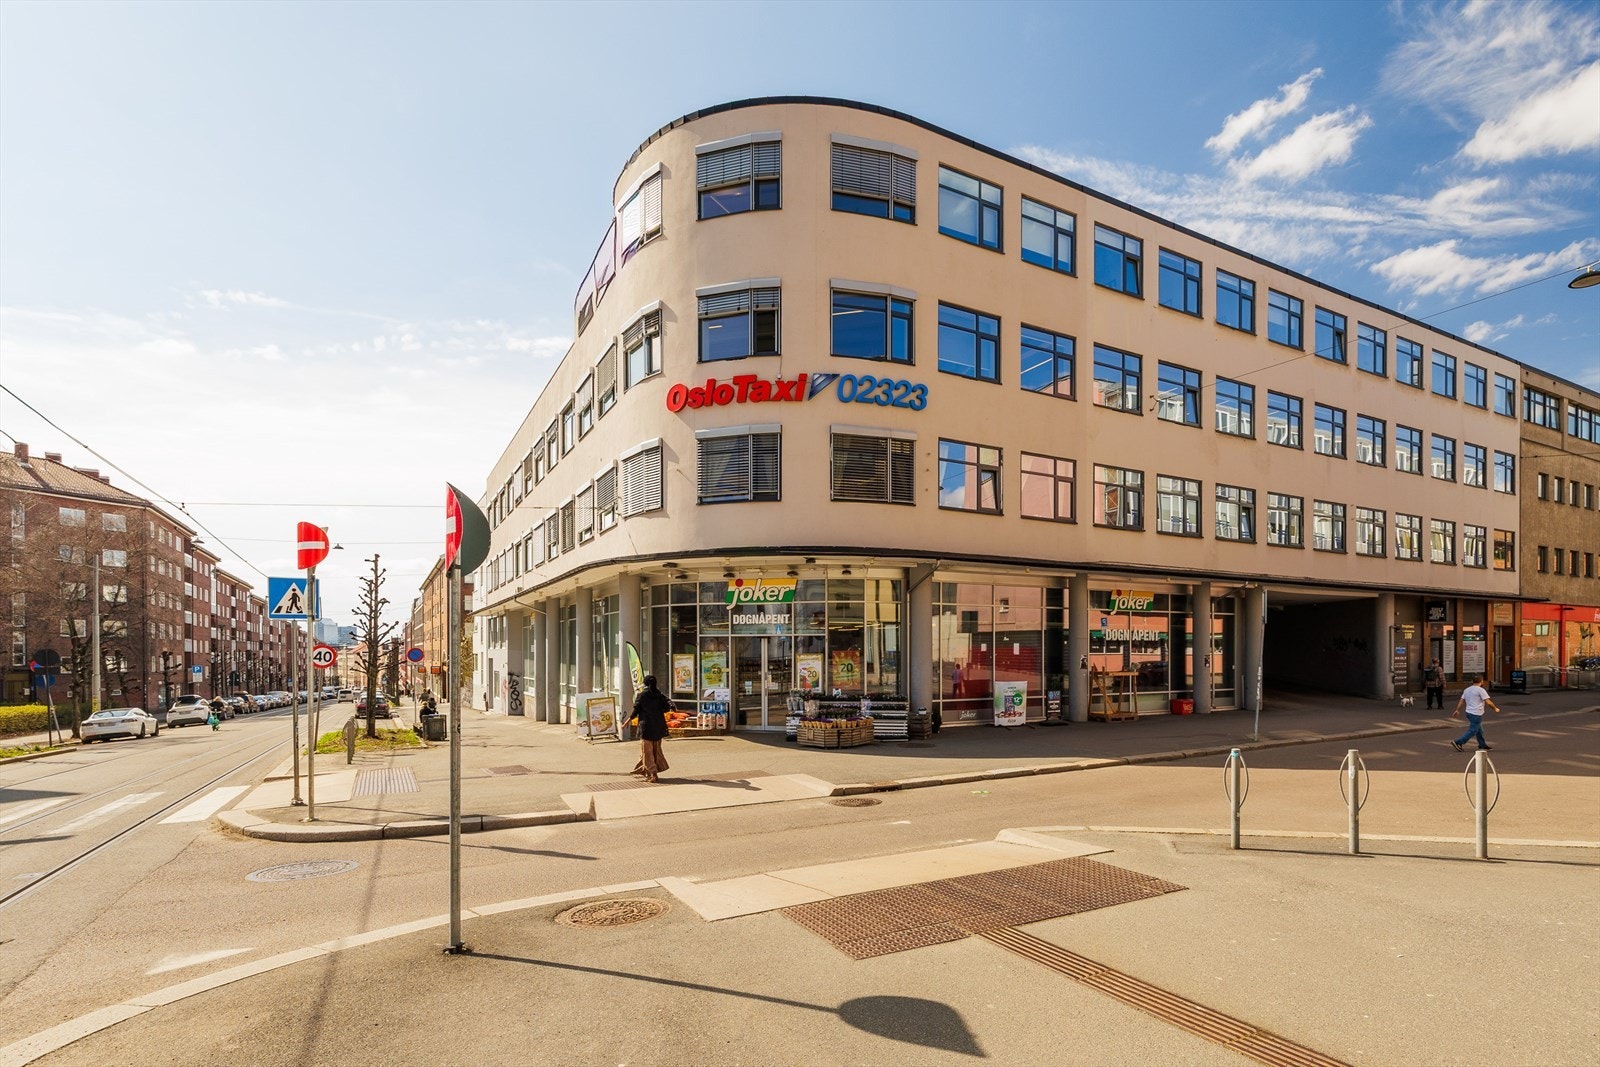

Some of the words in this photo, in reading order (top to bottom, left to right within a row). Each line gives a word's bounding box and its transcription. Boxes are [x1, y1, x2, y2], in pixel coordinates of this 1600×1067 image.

[666, 373, 808, 413] OsloTaxi
[837, 374, 929, 411] 02323
[726, 578, 790, 610] joker
[1110, 589, 1150, 615] joker
[733, 612, 790, 625] DØGNÅPENT
[313, 651, 332, 662] 40
[840, 663, 853, 672] 20
[807, 670, 817, 678] 20
[960, 710, 976, 720] joker
